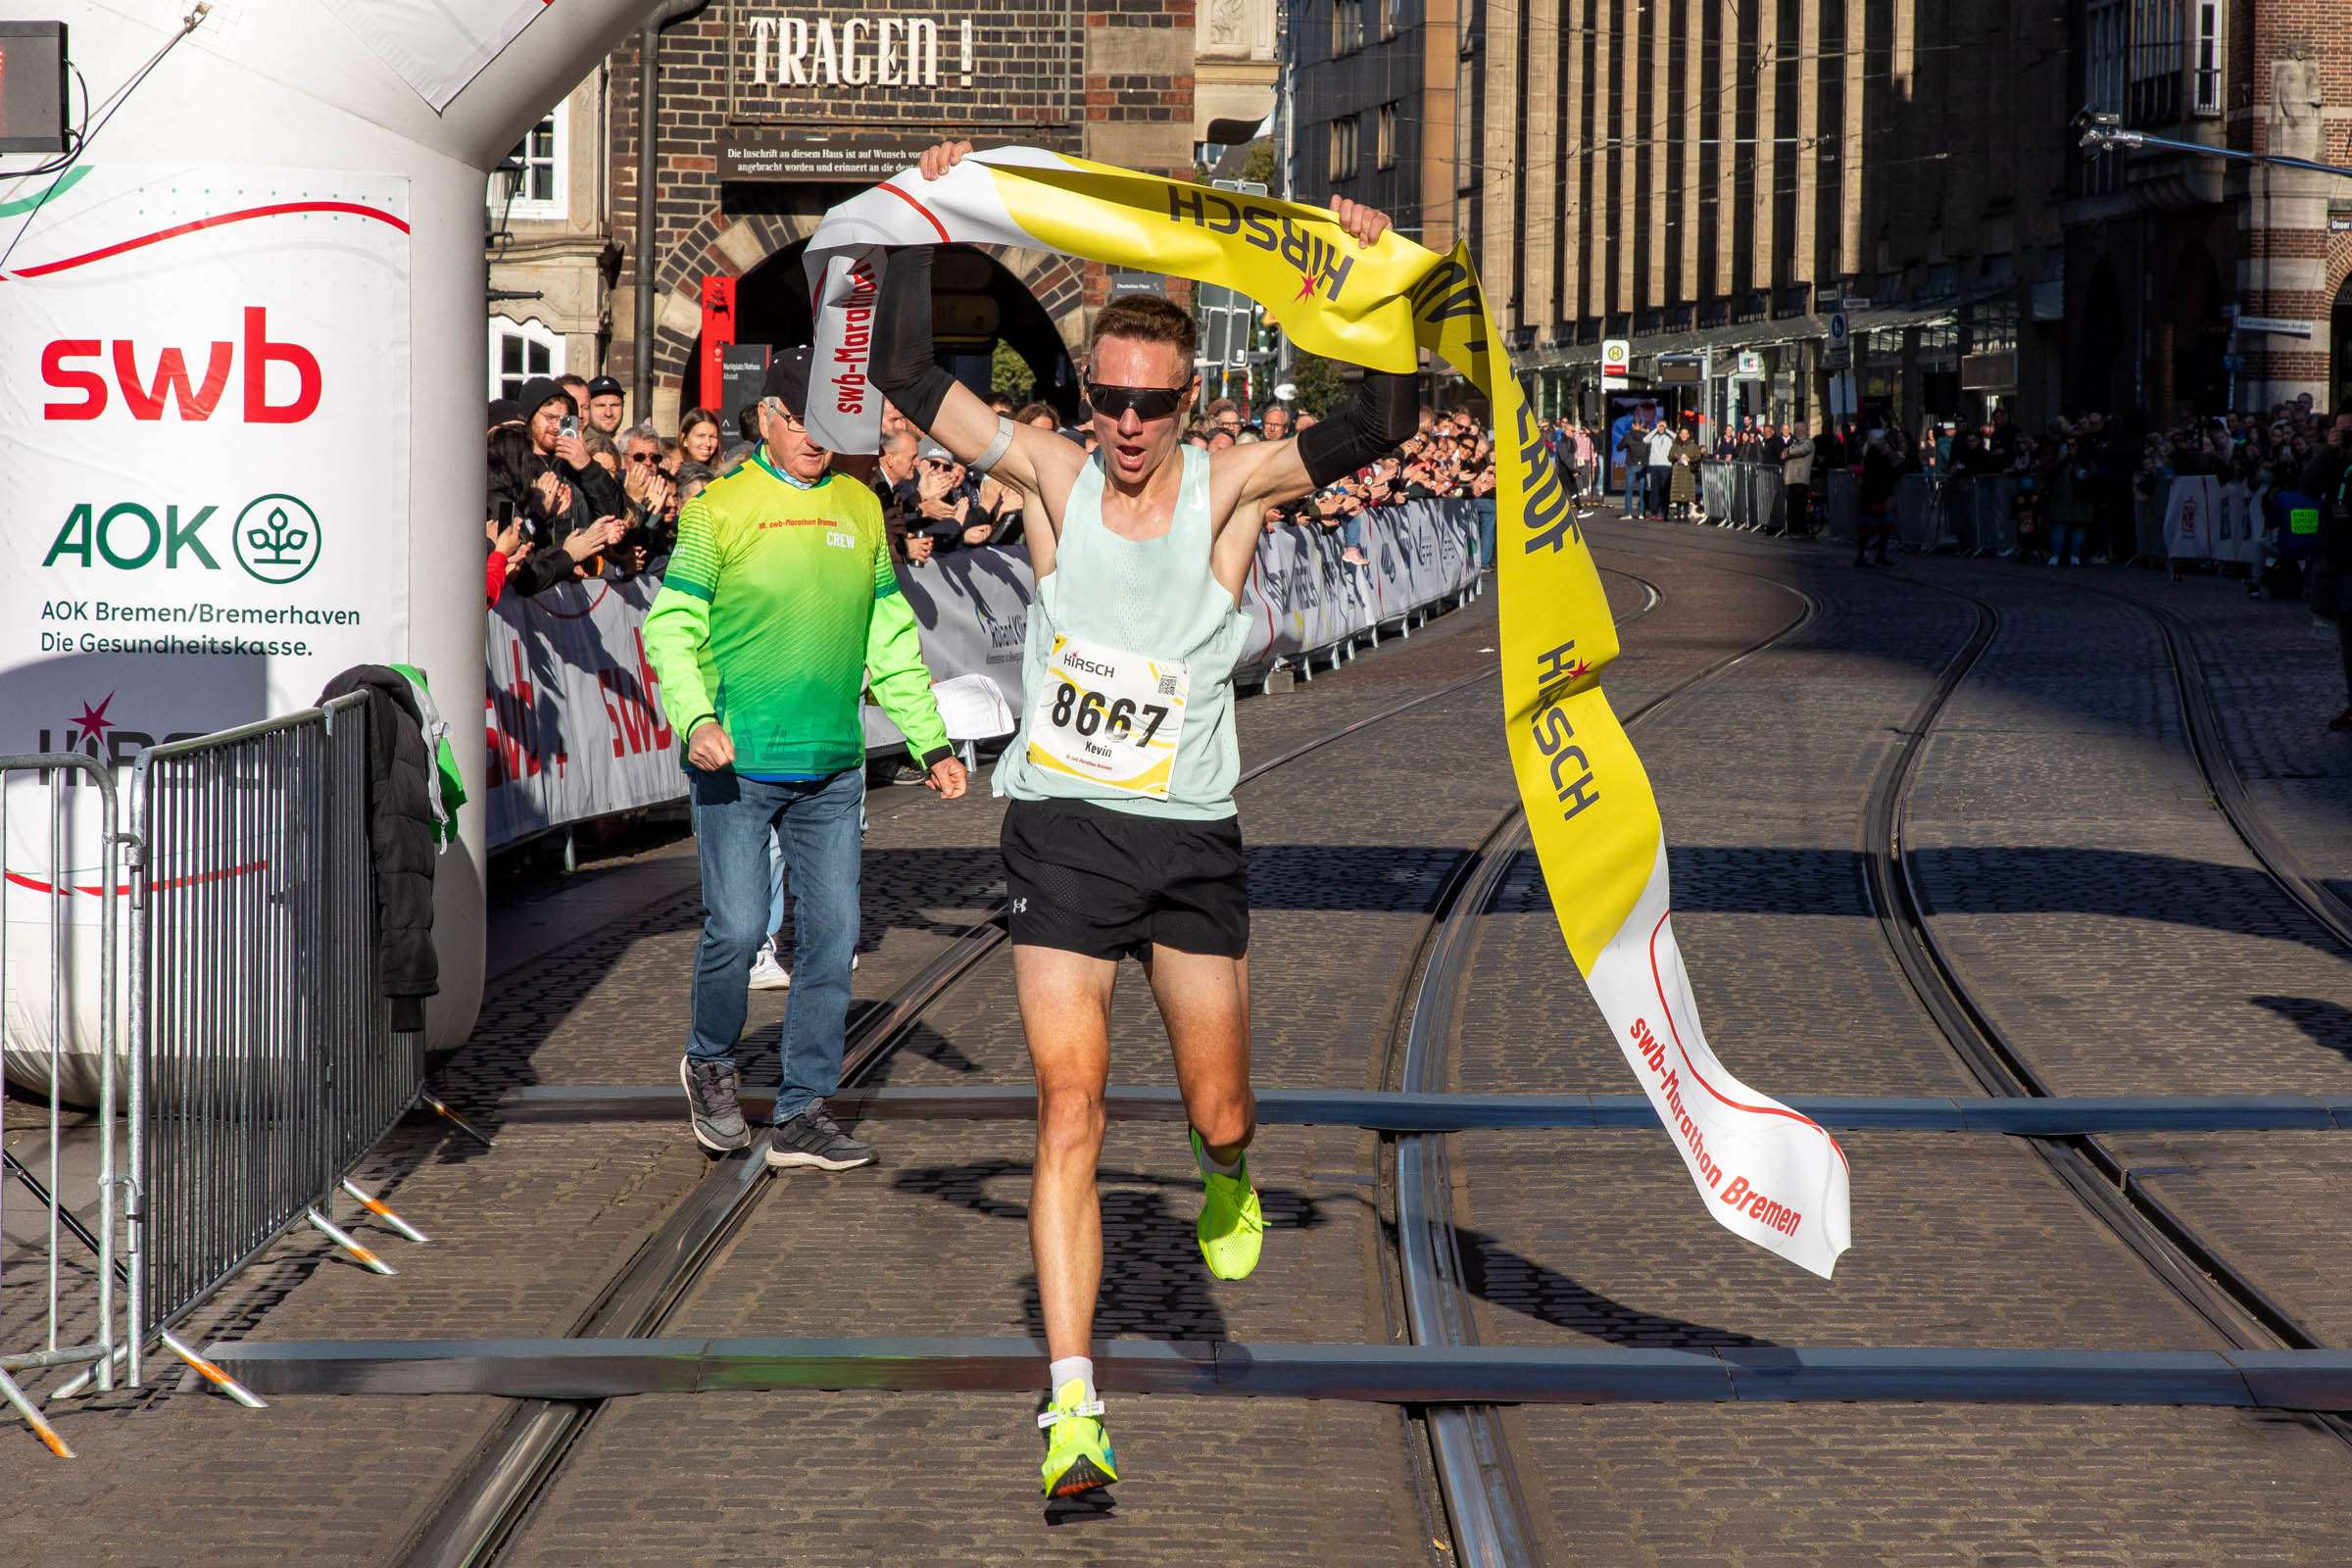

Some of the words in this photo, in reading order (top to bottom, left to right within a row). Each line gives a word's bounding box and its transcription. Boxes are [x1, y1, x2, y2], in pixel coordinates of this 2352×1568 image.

[750, 17, 938, 86] TRAGEN
[727, 148, 742, 159] Die
[743, 148, 777, 159] Inschrift
[791, 148, 821, 159] diesem
[822, 148, 844, 159] Haus
[845, 148, 857, 159] ist
[858, 148, 871, 159] auf
[872, 148, 906, 159] Wunsch
[737, 163, 782, 173] angebracht
[784, 164, 814, 172] worden
[816, 163, 833, 172] und
[834, 164, 867, 172] erinnert
[881, 164, 894, 172] die
[1167, 184, 1355, 302] HIRSCH
[41, 307, 321, 423] swb
[41, 502, 220, 569] AOK
[826, 532, 855, 550] CREW
[41, 601, 88, 622] AOK
[96, 603, 361, 625] Bremen/Bremerhaven
[41, 631, 74, 653] Die
[79, 633, 313, 658] Gesundheitskasse.
[1063, 654, 1115, 678] HIRSCH
[596, 626, 672, 758] swb
[1052, 682, 1169, 749] 8667
[1085, 741, 1112, 758] Kevin
[1630, 1018, 1723, 1190] swb-Marathon
[1721, 1176, 1801, 1237] Bremen
